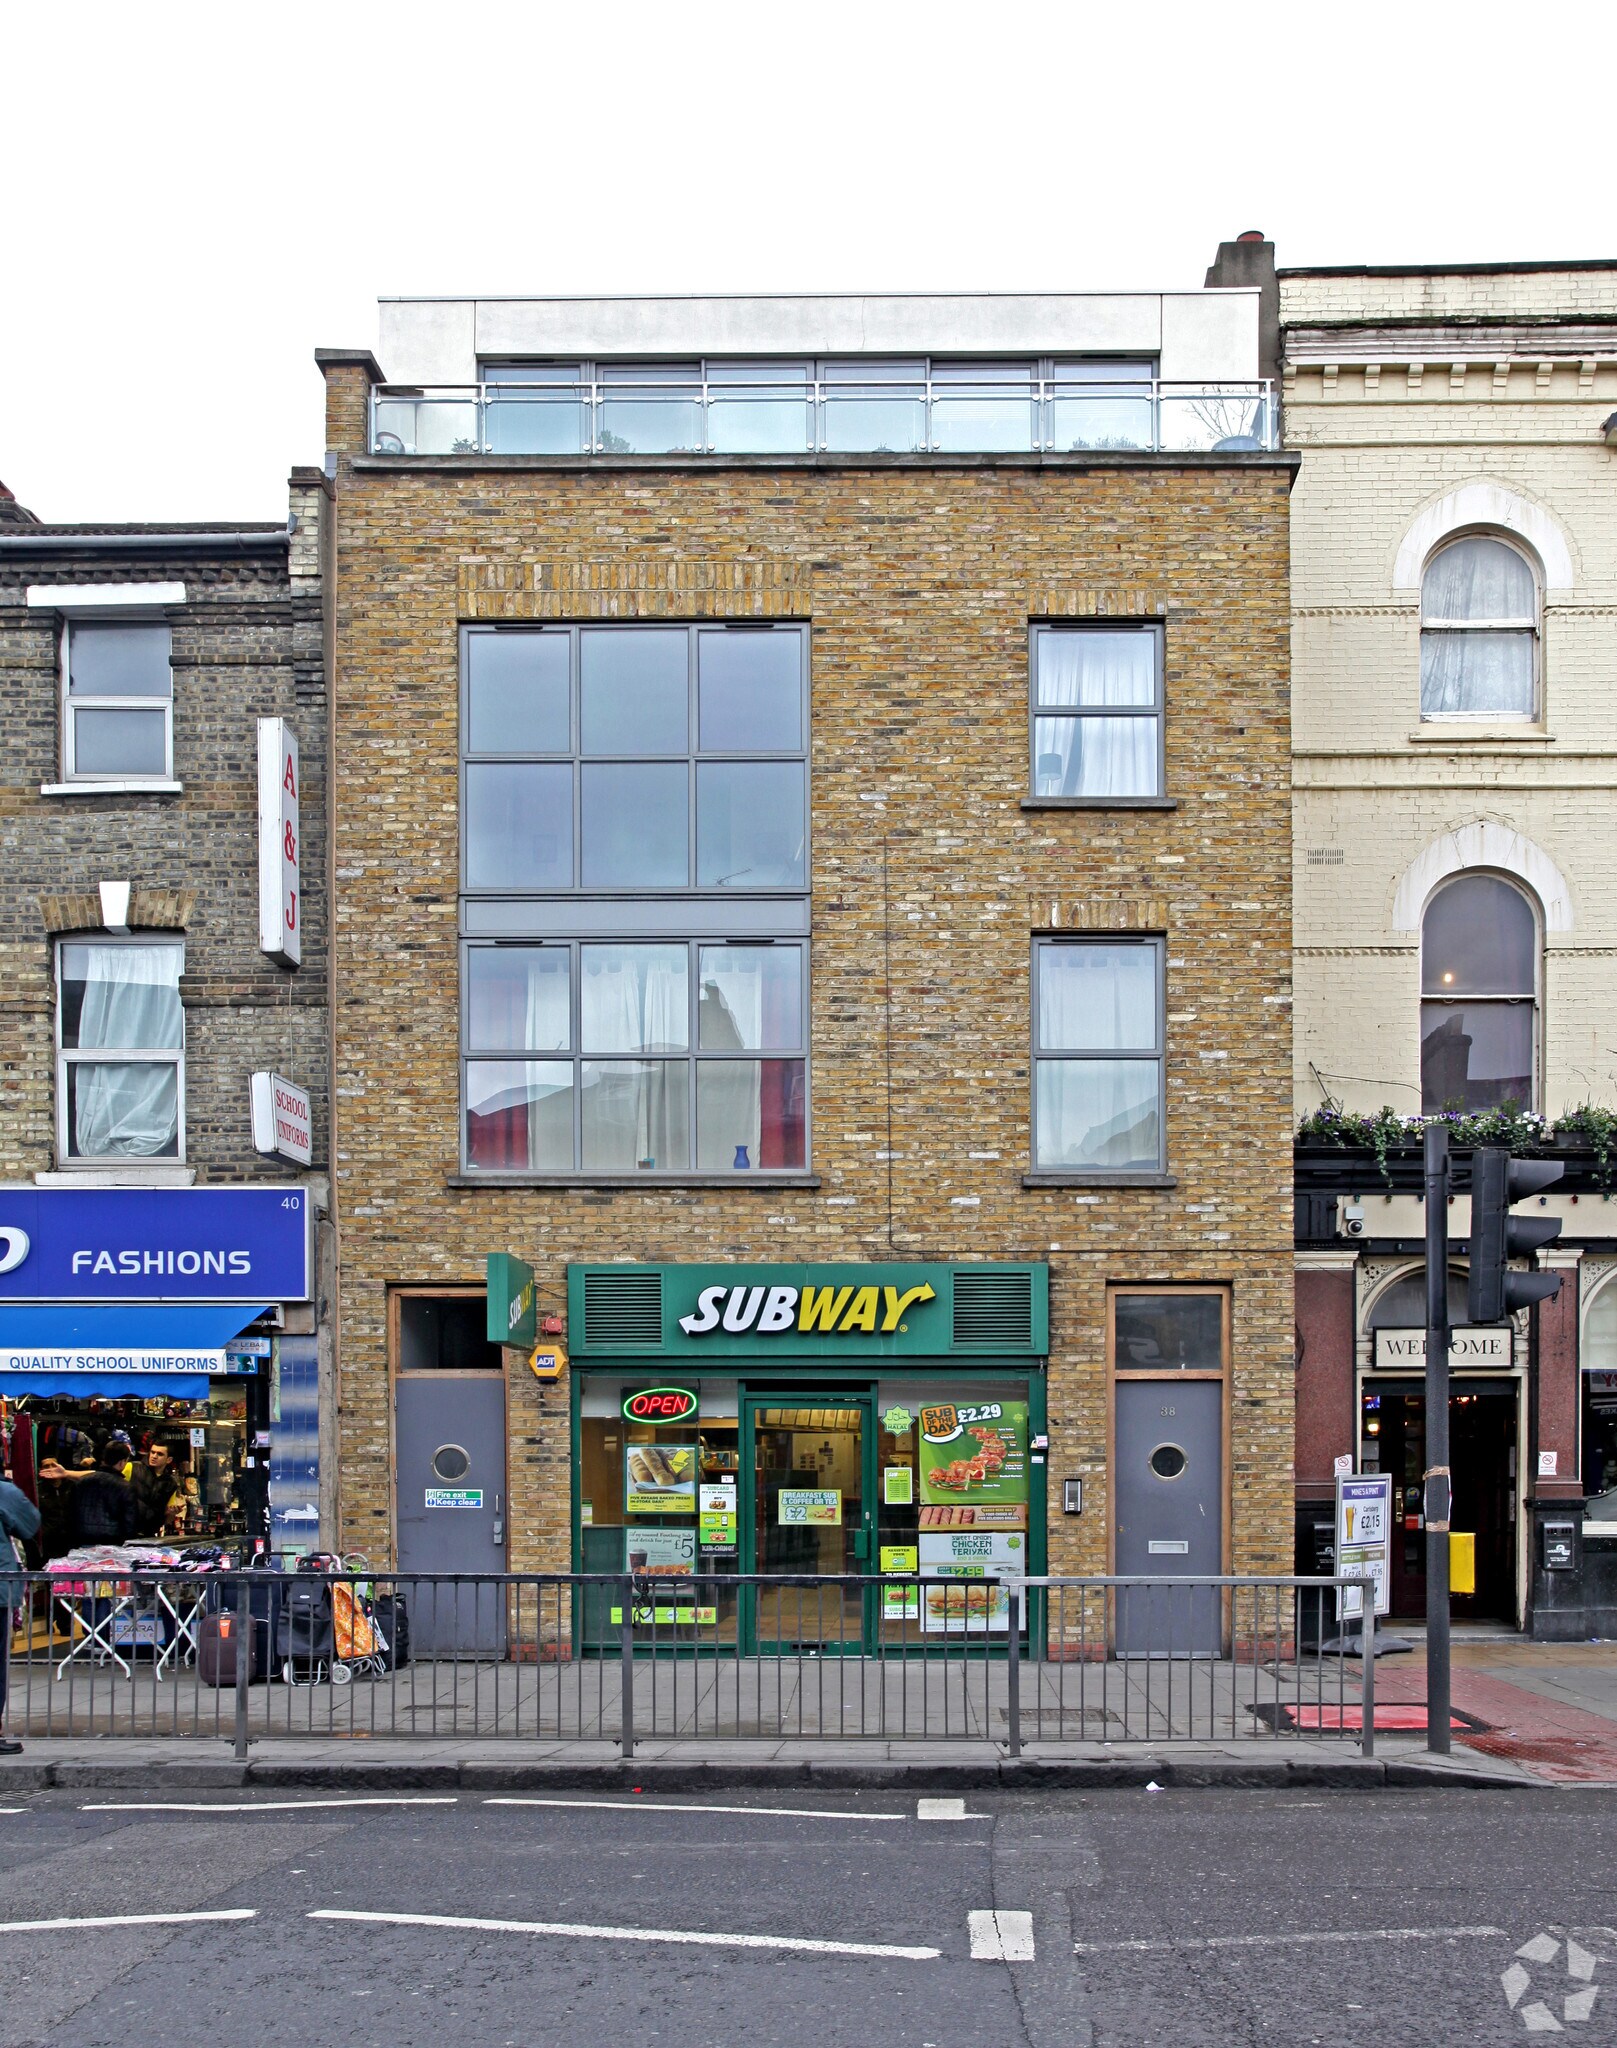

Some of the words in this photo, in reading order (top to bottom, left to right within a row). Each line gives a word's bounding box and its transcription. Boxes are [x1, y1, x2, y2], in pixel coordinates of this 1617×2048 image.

[282, 753, 296, 798] A
[283, 819, 297, 866] &
[285, 890, 296, 931] J
[275, 1088, 308, 1121] SCHOOL
[277, 1119, 309, 1149] UNIFORMS
[281, 1196, 300, 1210] 40
[72, 1250, 251, 1275] FASHIONS
[678, 1280, 937, 1335] SUBWAY
[1386, 1339, 1502, 1355] WEOME
[9, 1356, 74, 1371] QUALITY
[76, 1357, 139, 1371] SCHOOL
[141, 1356, 218, 1371] UNIFORMS
[536, 1356, 555, 1367] ADT
[632, 1396, 689, 1415] OPEN
[957, 1403, 1002, 1423] £2.29
[1160, 1406, 1176, 1417] 38
[925, 1407, 953, 1420] SUB
[926, 1418, 937, 1426] OF
[938, 1416, 953, 1425] THE
[928, 1423, 955, 1435] DAY
[783, 1491, 822, 1499] BREAKFAST
[822, 1491, 837, 1499] SUB
[785, 1506, 807, 1521] £2
[1361, 1515, 1380, 1529] £2.15
[674, 1537, 694, 1559] £5
[951, 1540, 992, 1548] CHICKEN
[951, 1548, 992, 1556] TERIYAKI
